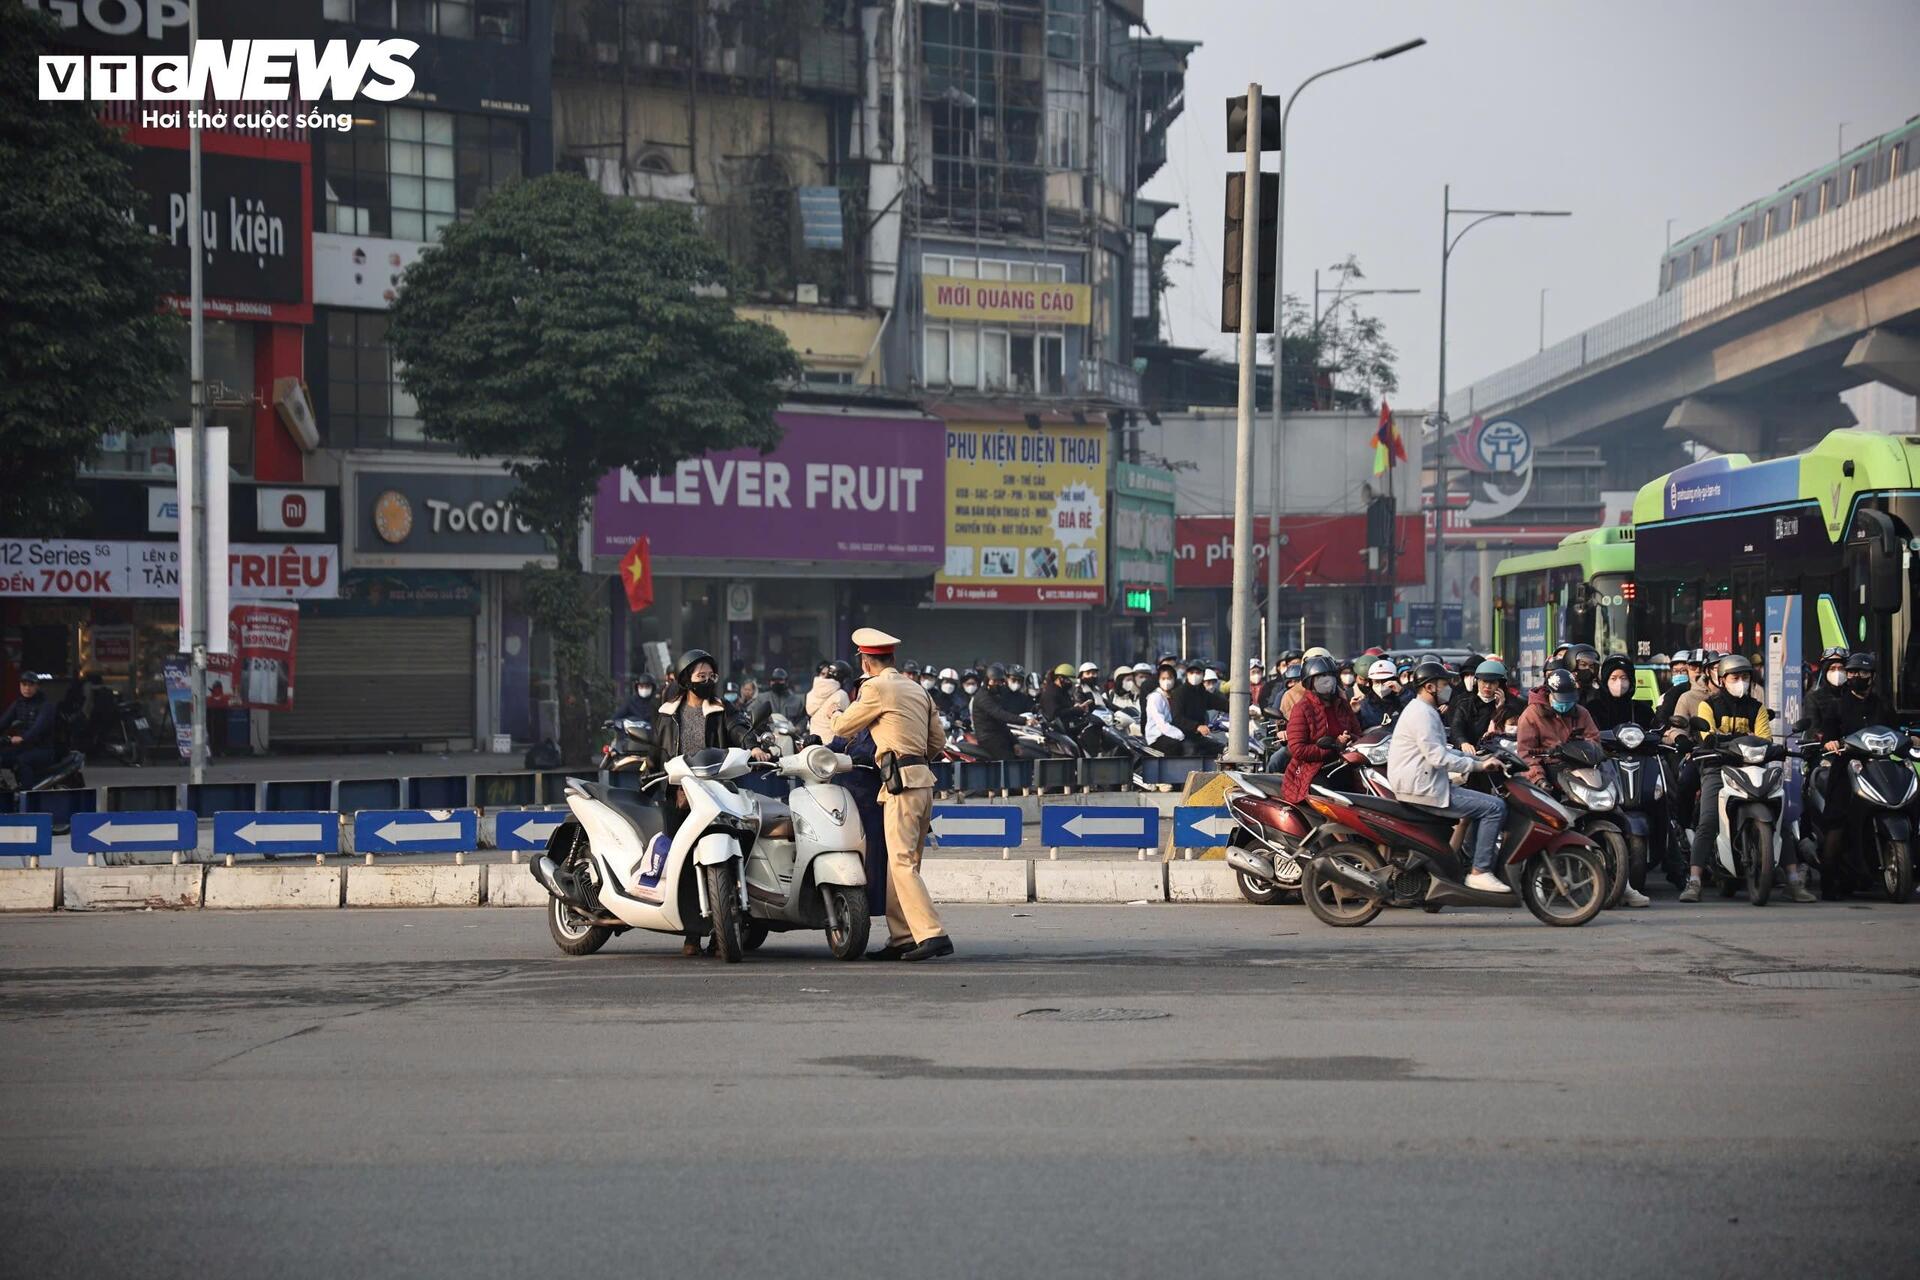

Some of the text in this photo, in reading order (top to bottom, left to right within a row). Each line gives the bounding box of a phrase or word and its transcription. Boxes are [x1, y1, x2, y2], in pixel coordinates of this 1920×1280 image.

[230, 196, 284, 269] kiện
[1041, 288, 1074, 312] CÁO
[946, 429, 1101, 470] PHỤ KIỆN ĐIỆN THOẠI
[619, 458, 924, 513] KLEVER FRUIT
[1058, 506, 1092, 529] GIÁ RẺ
[29, 543, 91, 566] Series
[95, 545, 111, 556] 5G
[40, 570, 112, 593] 700K
[143, 564, 179, 588] TẶN
[228, 544, 328, 595] TRIỆU
[142, 549, 166, 562] LÊN
